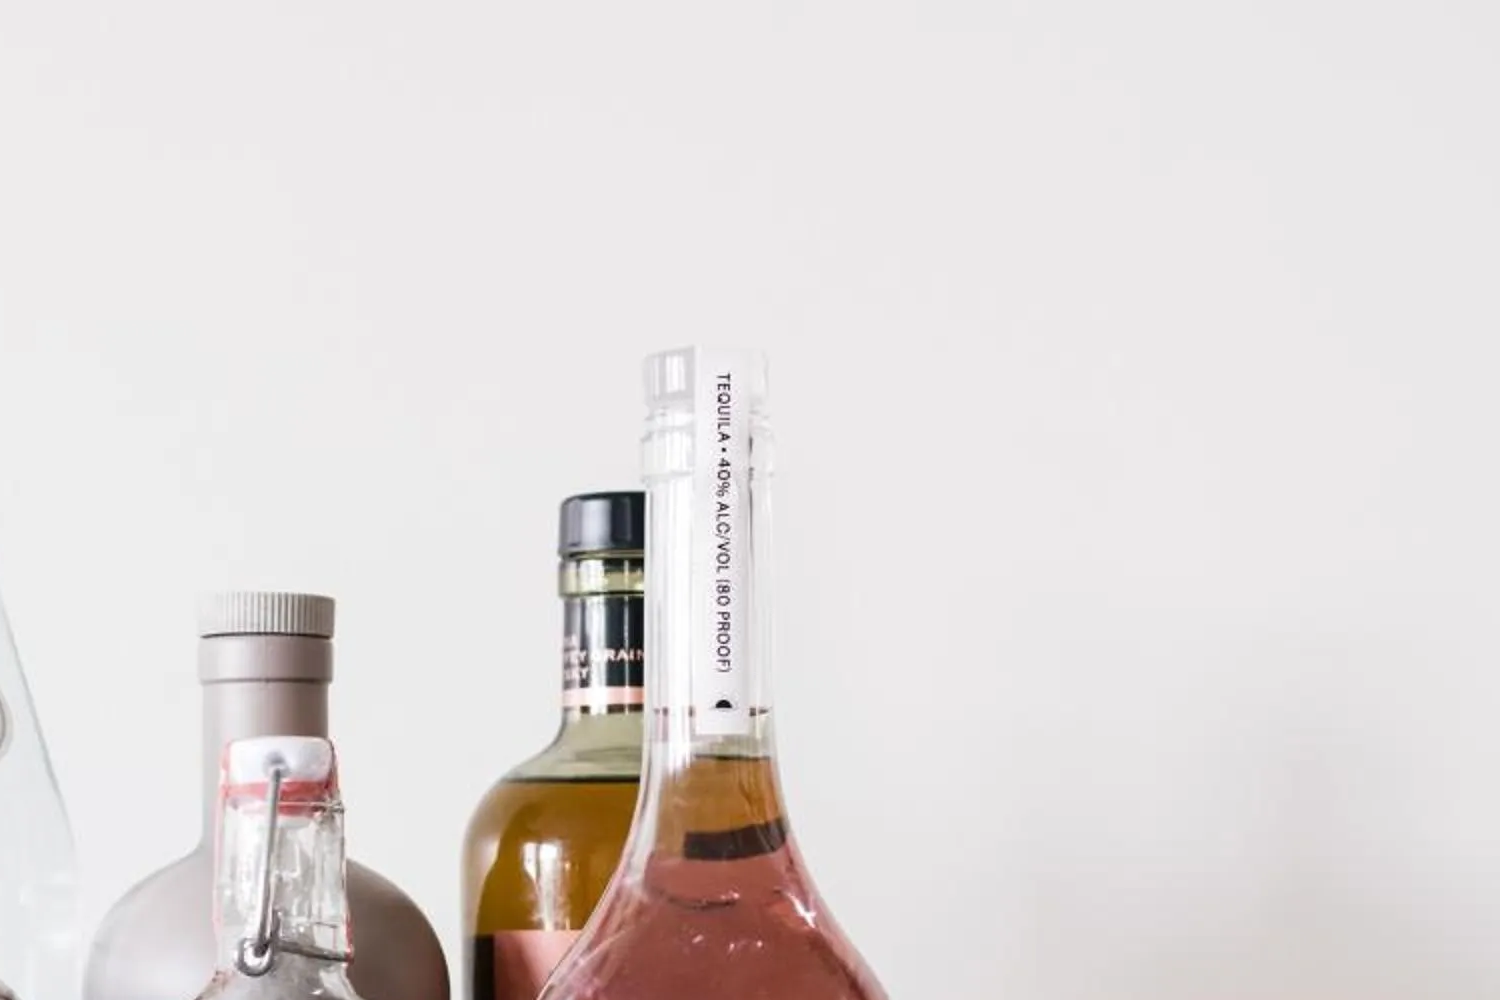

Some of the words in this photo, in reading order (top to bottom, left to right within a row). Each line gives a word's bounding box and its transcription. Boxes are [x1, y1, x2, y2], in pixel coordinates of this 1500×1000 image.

[717, 372, 731, 442] TEQUILA
[716, 458, 731, 497] 40%
[716, 501, 731, 573] ALC/VOL
[716, 579, 731, 607] (80
[714, 611, 732, 673] PROOF)
